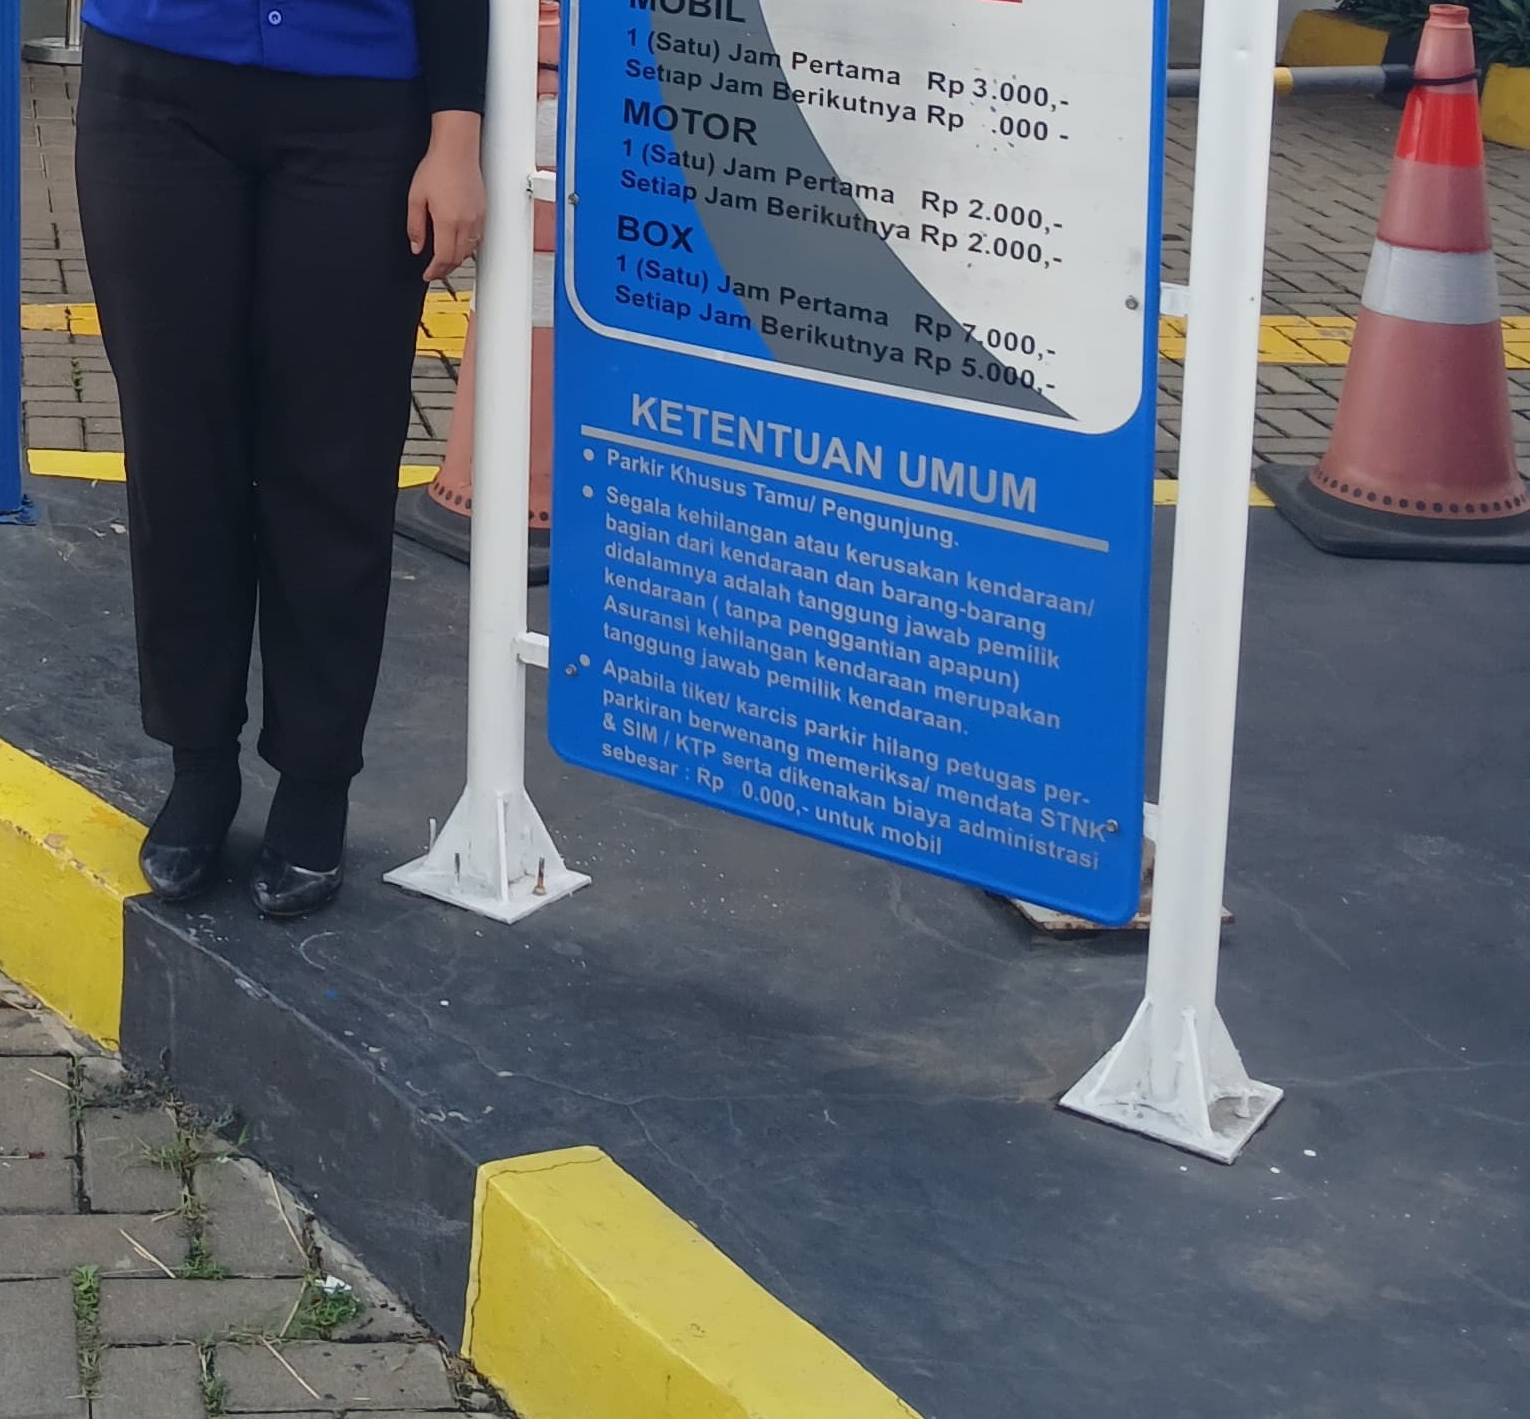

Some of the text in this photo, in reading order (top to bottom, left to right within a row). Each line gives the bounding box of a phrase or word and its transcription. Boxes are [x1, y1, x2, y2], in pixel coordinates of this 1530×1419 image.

[623, 97, 757, 146] MOTOR
[625, 59, 701, 91] Setiap
[710, 73, 762, 98] Jam
[772, 80, 917, 122] Berikutnya
[927, 104, 964, 131] Rp
[628, 29, 1069, 112] 1 (Satu) Jam Pertama Rp 3.000,-
[618, 215, 693, 253] BOX
[621, 170, 1062, 269] Setiap Jam Berikutnya Rp 2.000,-
[623, 139, 1063, 234] 1 (Satu) Jam Pertama Rp 2.000,-
[615, 285, 1055, 394] Setiap Jam Berikutnya Rp 5.000,-
[617, 255, 1055, 361] 1 (Satu) Jam Pertama Rp 7.000,-
[608, 448, 959, 548] Parkir Khusus Tamu/ Pengunjung.
[632, 393, 1036, 513] KETENTUAN UMUM
[605, 513, 1046, 640] bagian dari kendaraan dan barang-barang
[605, 541, 1059, 669] didalamnya adalah tanggung jawab pemilik
[606, 486, 1094, 617] Segala kehilangan atau kerusakan kendaraan/
[604, 566, 705, 608] kendaraan
[725, 600, 782, 628] tanpa
[789, 618, 921, 664] penggantian
[929, 654, 1019, 693] apapun)
[604, 595, 1060, 729] Asuransi kehilangan kendaraan merupakan
[604, 622, 968, 736] tanggung jawab pemilik kendaraan.
[603, 659, 1090, 805] Apabila tiket/ karcis parkir hilang petugas per-
[604, 689, 1107, 842] parkiran berwenang memeriksa/ mendata STNK
[602, 743, 678, 776] sebesar
[697, 766, 723, 793] Rp
[815, 805, 875, 835] untuk
[882, 826, 941, 855] mobil
[603, 712, 616, 731] &
[623, 718, 657, 744] SIM
[676, 733, 716, 758] KTP
[722, 750, 772, 776] serta
[779, 765, 886, 810] dikenakan
[894, 796, 950, 829] biaya
[959, 820, 1098, 870] administrasi
